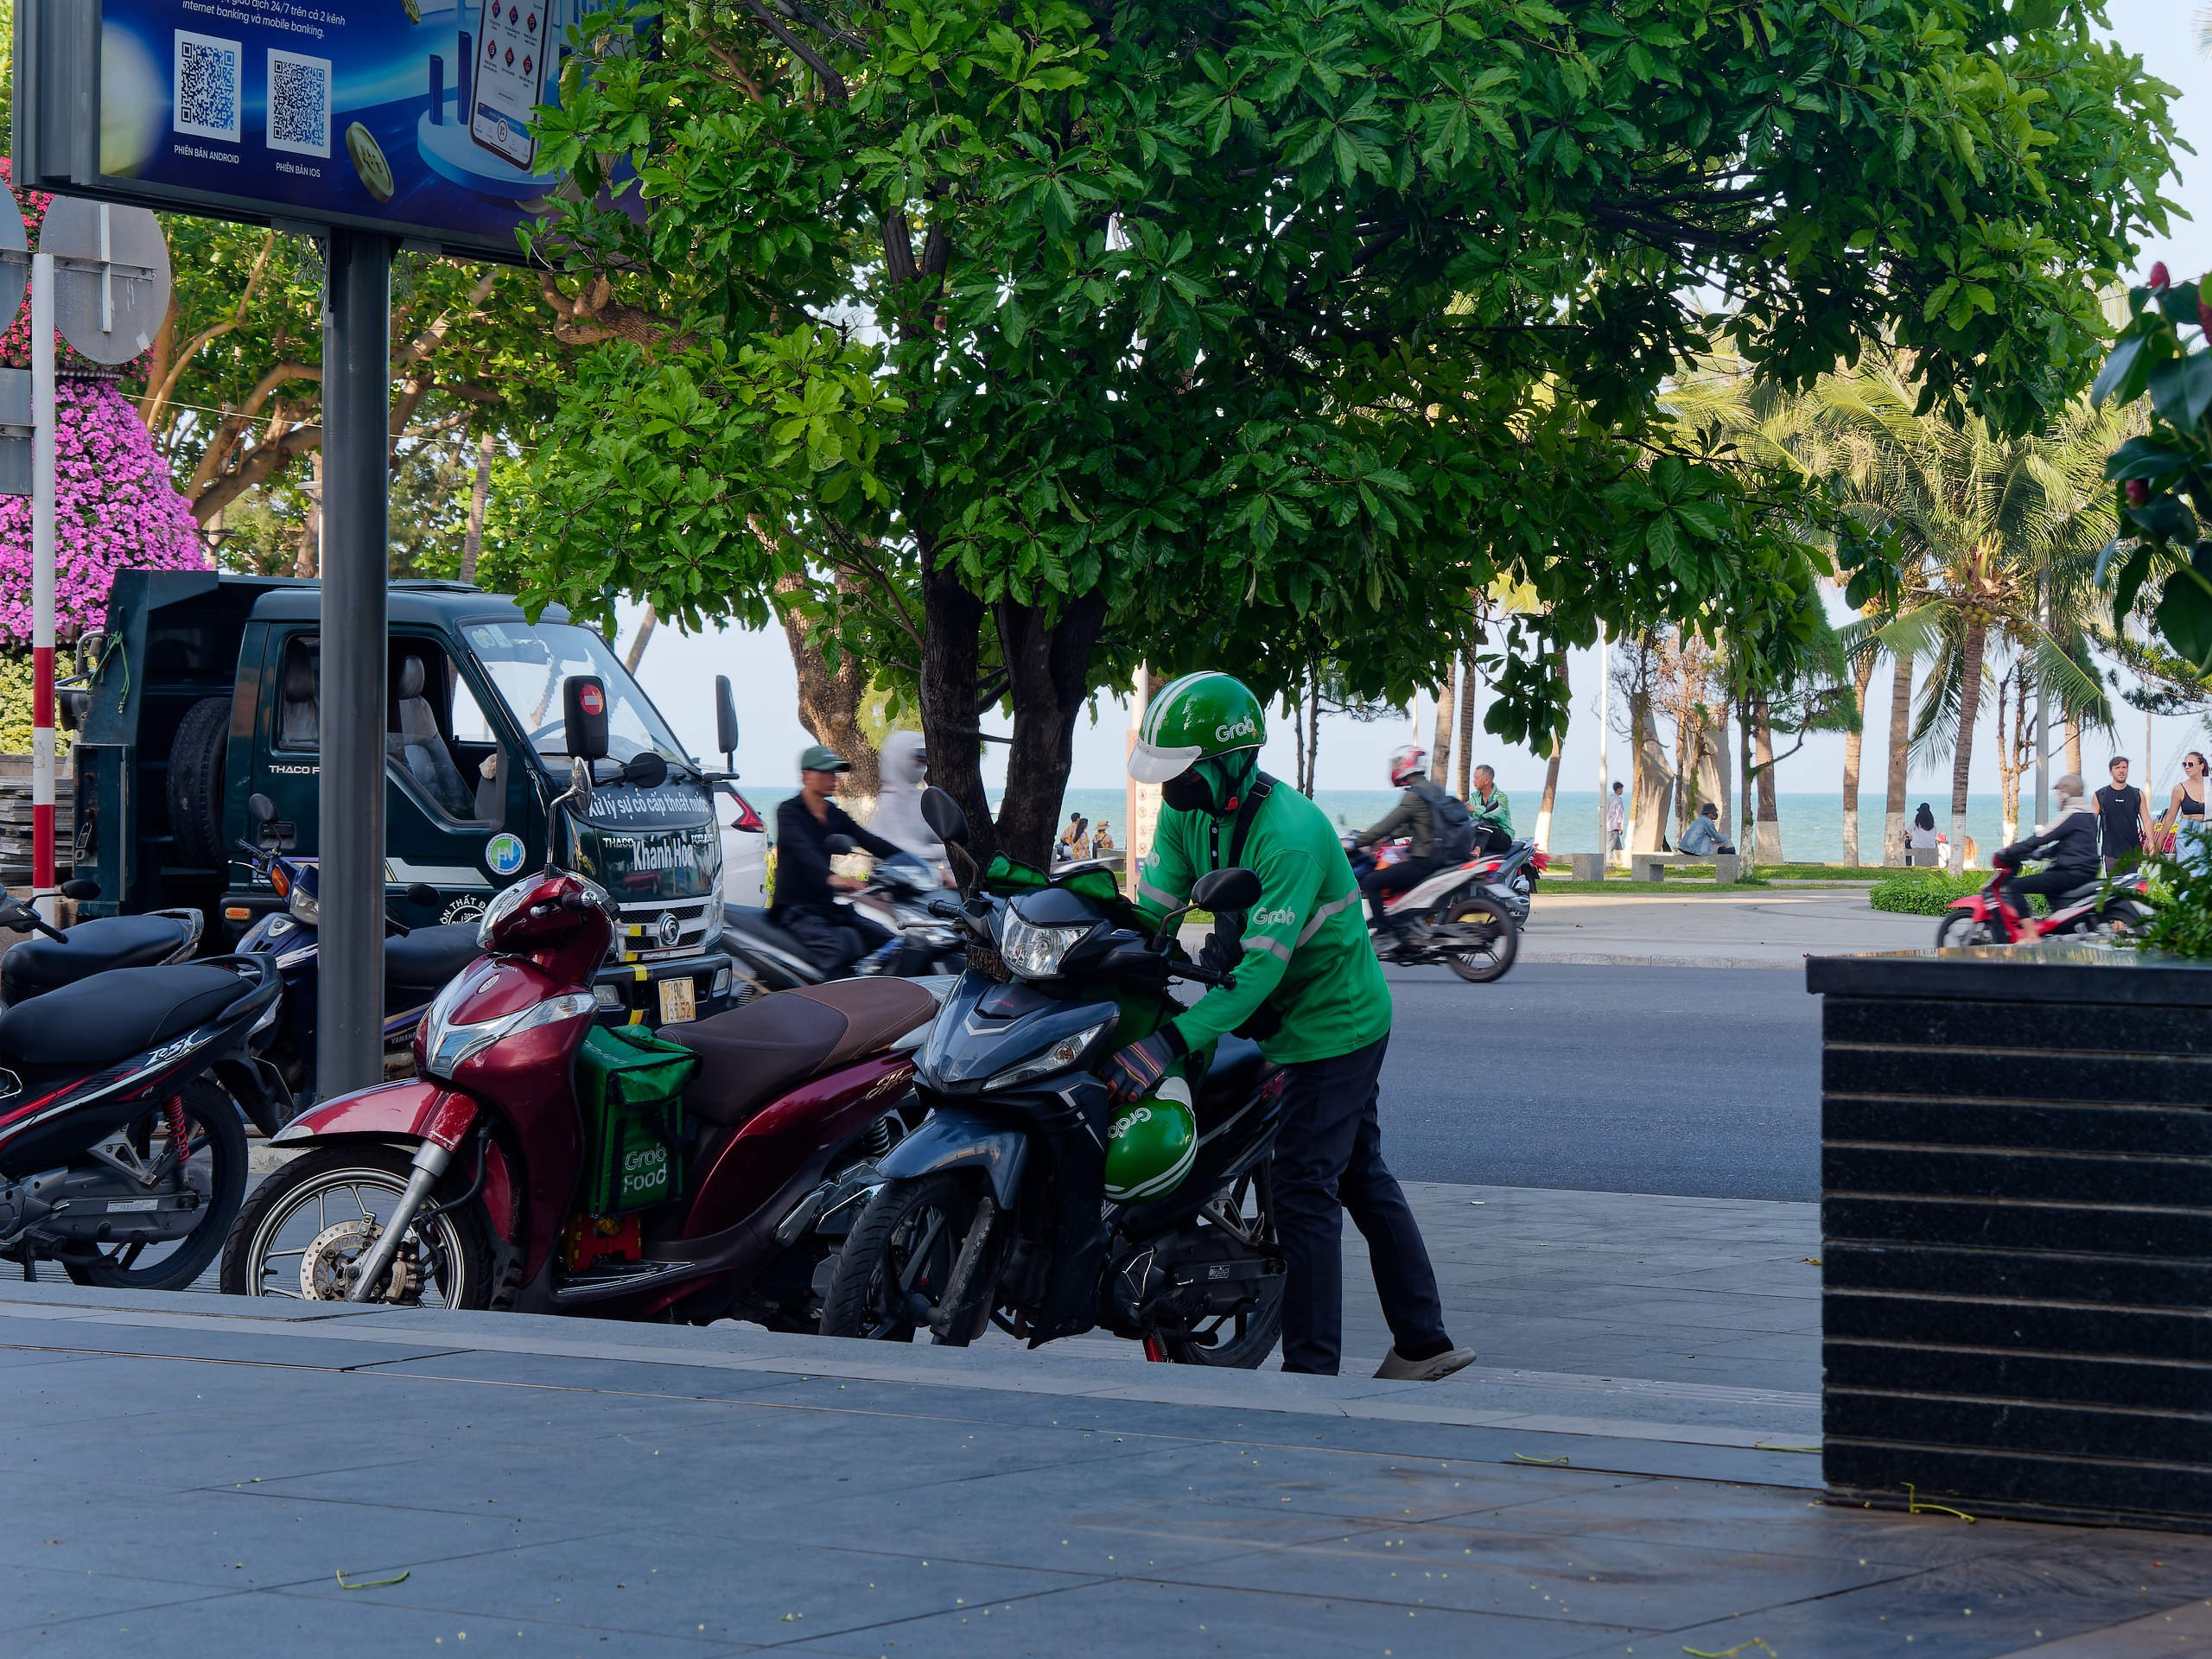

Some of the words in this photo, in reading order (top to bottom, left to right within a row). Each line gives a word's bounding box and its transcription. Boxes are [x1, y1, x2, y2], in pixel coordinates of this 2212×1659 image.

[216, 5, 250, 23] banking
[251, 14, 261, 24] và
[262, 17, 289, 29] mobile
[290, 21, 325, 39] banking.
[251, 0, 270, 10] dịch
[270, 1, 289, 13] 24/7
[290, 6, 307, 17] trên
[320, 11, 326, 22] 2
[326, 13, 346, 26] kênh
[175, 145, 194, 156] PHIÊN
[194, 149, 208, 159] BẢN
[209, 151, 239, 164] ANDROID
[276, 162, 295, 174] PHIÊN
[309, 168, 321, 178] IOS
[1215, 715, 1255, 742] Grab
[269, 766, 310, 774] THACO
[633, 835, 672, 871] Khánh
[440, 909, 452, 925] ÔN
[449, 894, 477, 910] THẤT
[1253, 906, 1295, 926] Grab
[1107, 1107, 1152, 1139] Grab
[625, 1141, 666, 1170] Grab
[624, 1162, 666, 1192] Food
